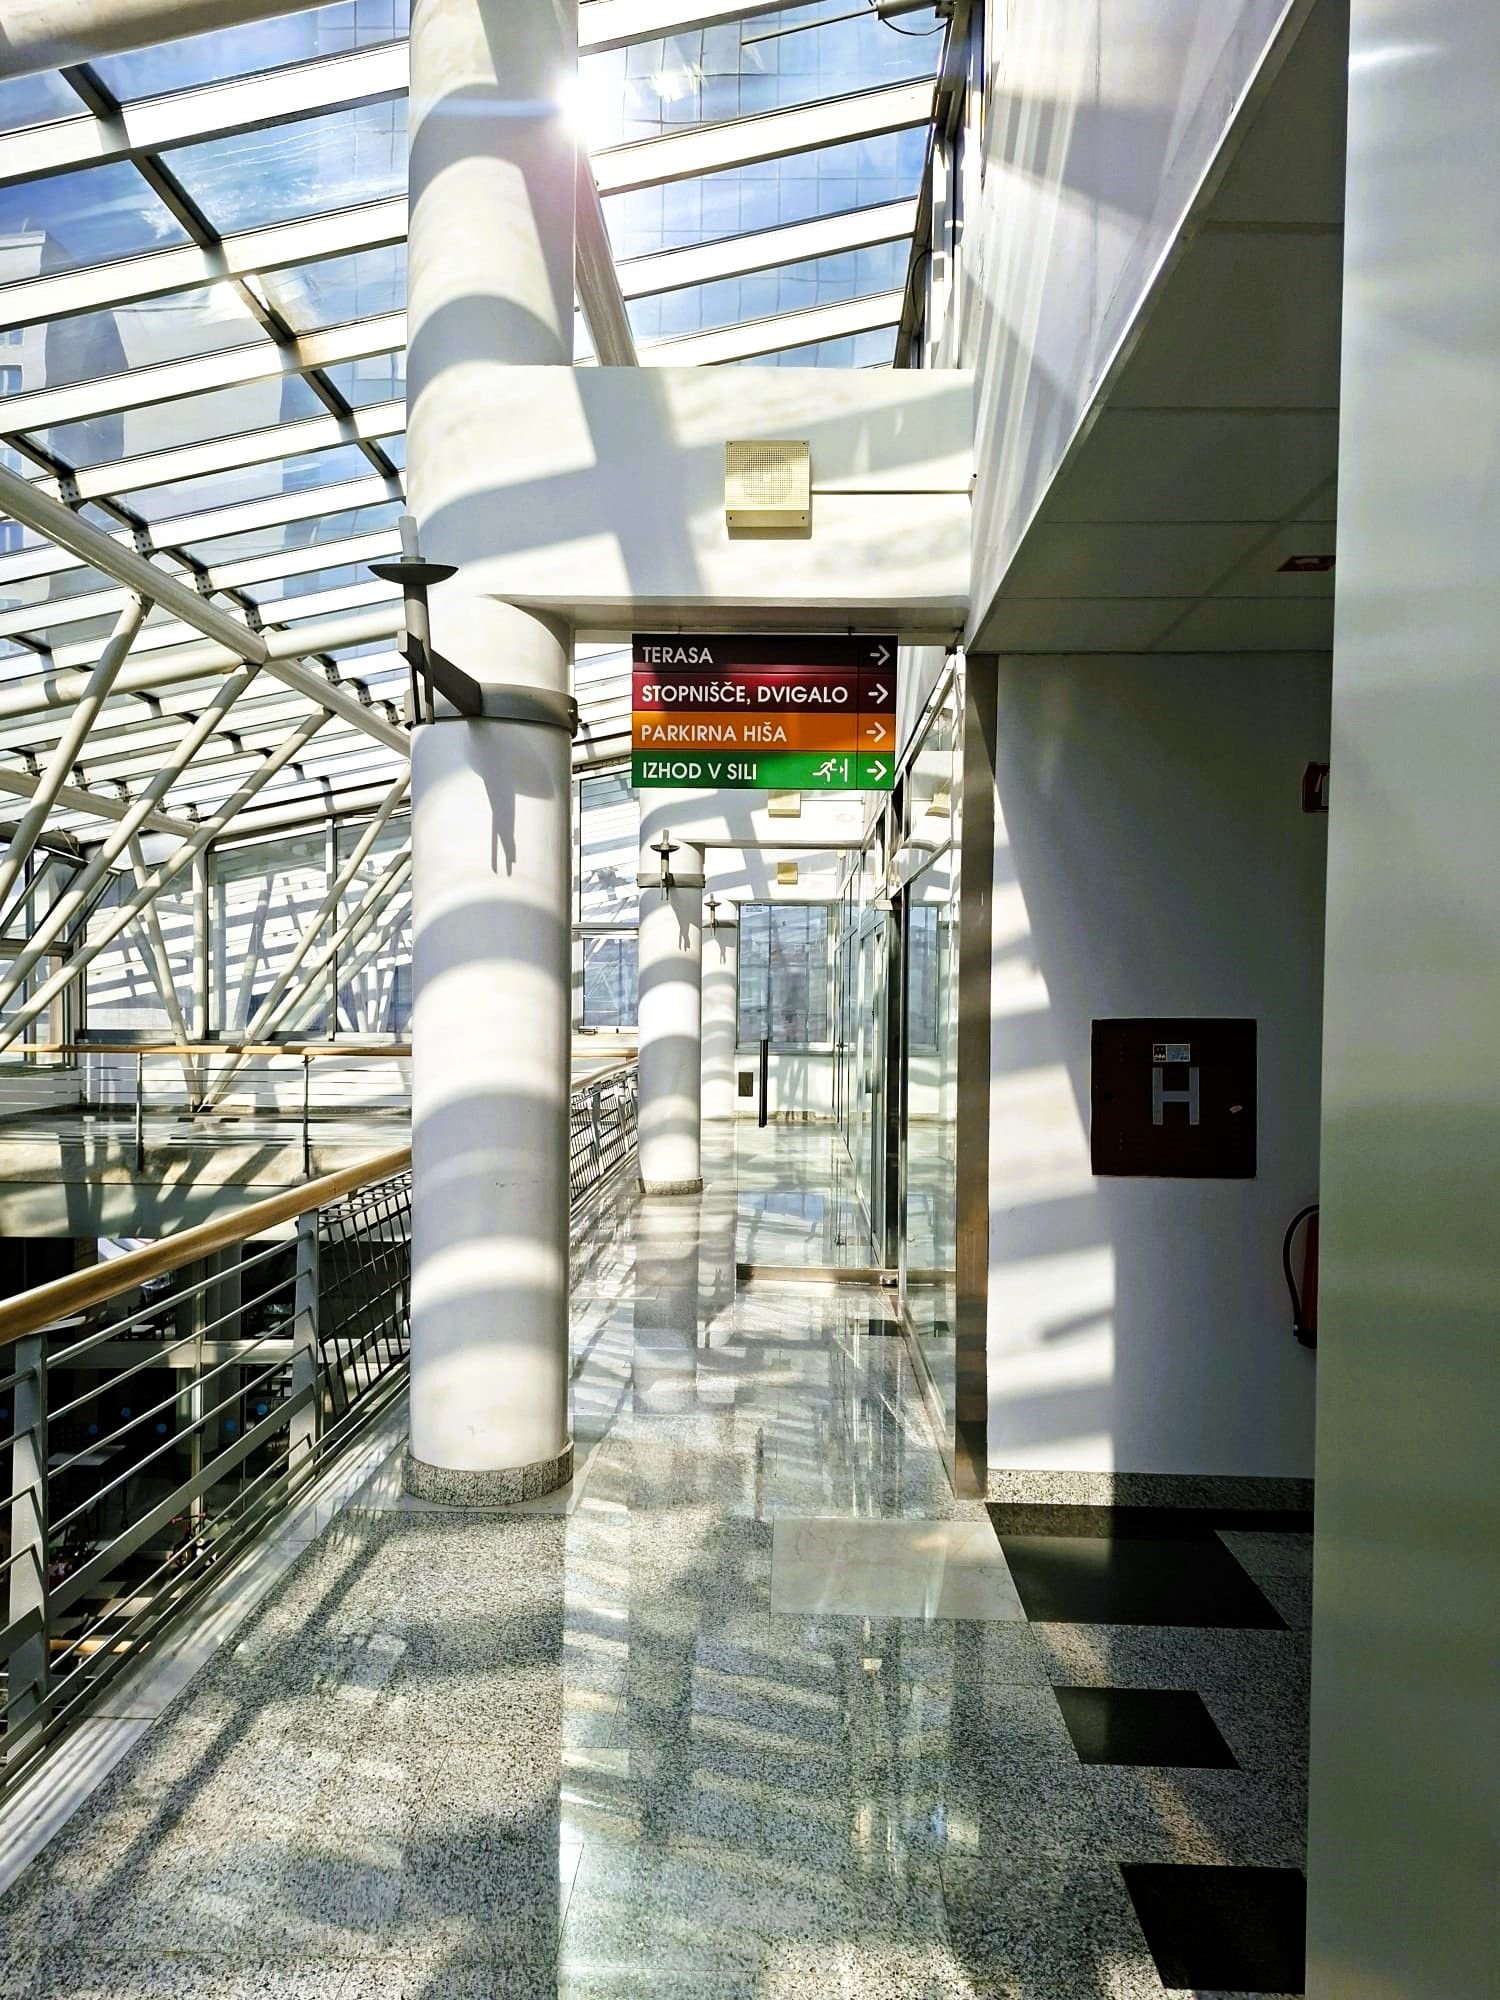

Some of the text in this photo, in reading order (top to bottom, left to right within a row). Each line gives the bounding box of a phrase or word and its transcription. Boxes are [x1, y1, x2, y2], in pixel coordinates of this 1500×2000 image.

[642, 646, 713, 663] TERASA
[641, 681, 848, 705] STOPNIŠČE, DVIGALO
[641, 721, 787, 742] PARKIRNA HIŠA
[643, 762, 757, 780] IZHOD V SILI
[1152, 1067, 1200, 1125] H
